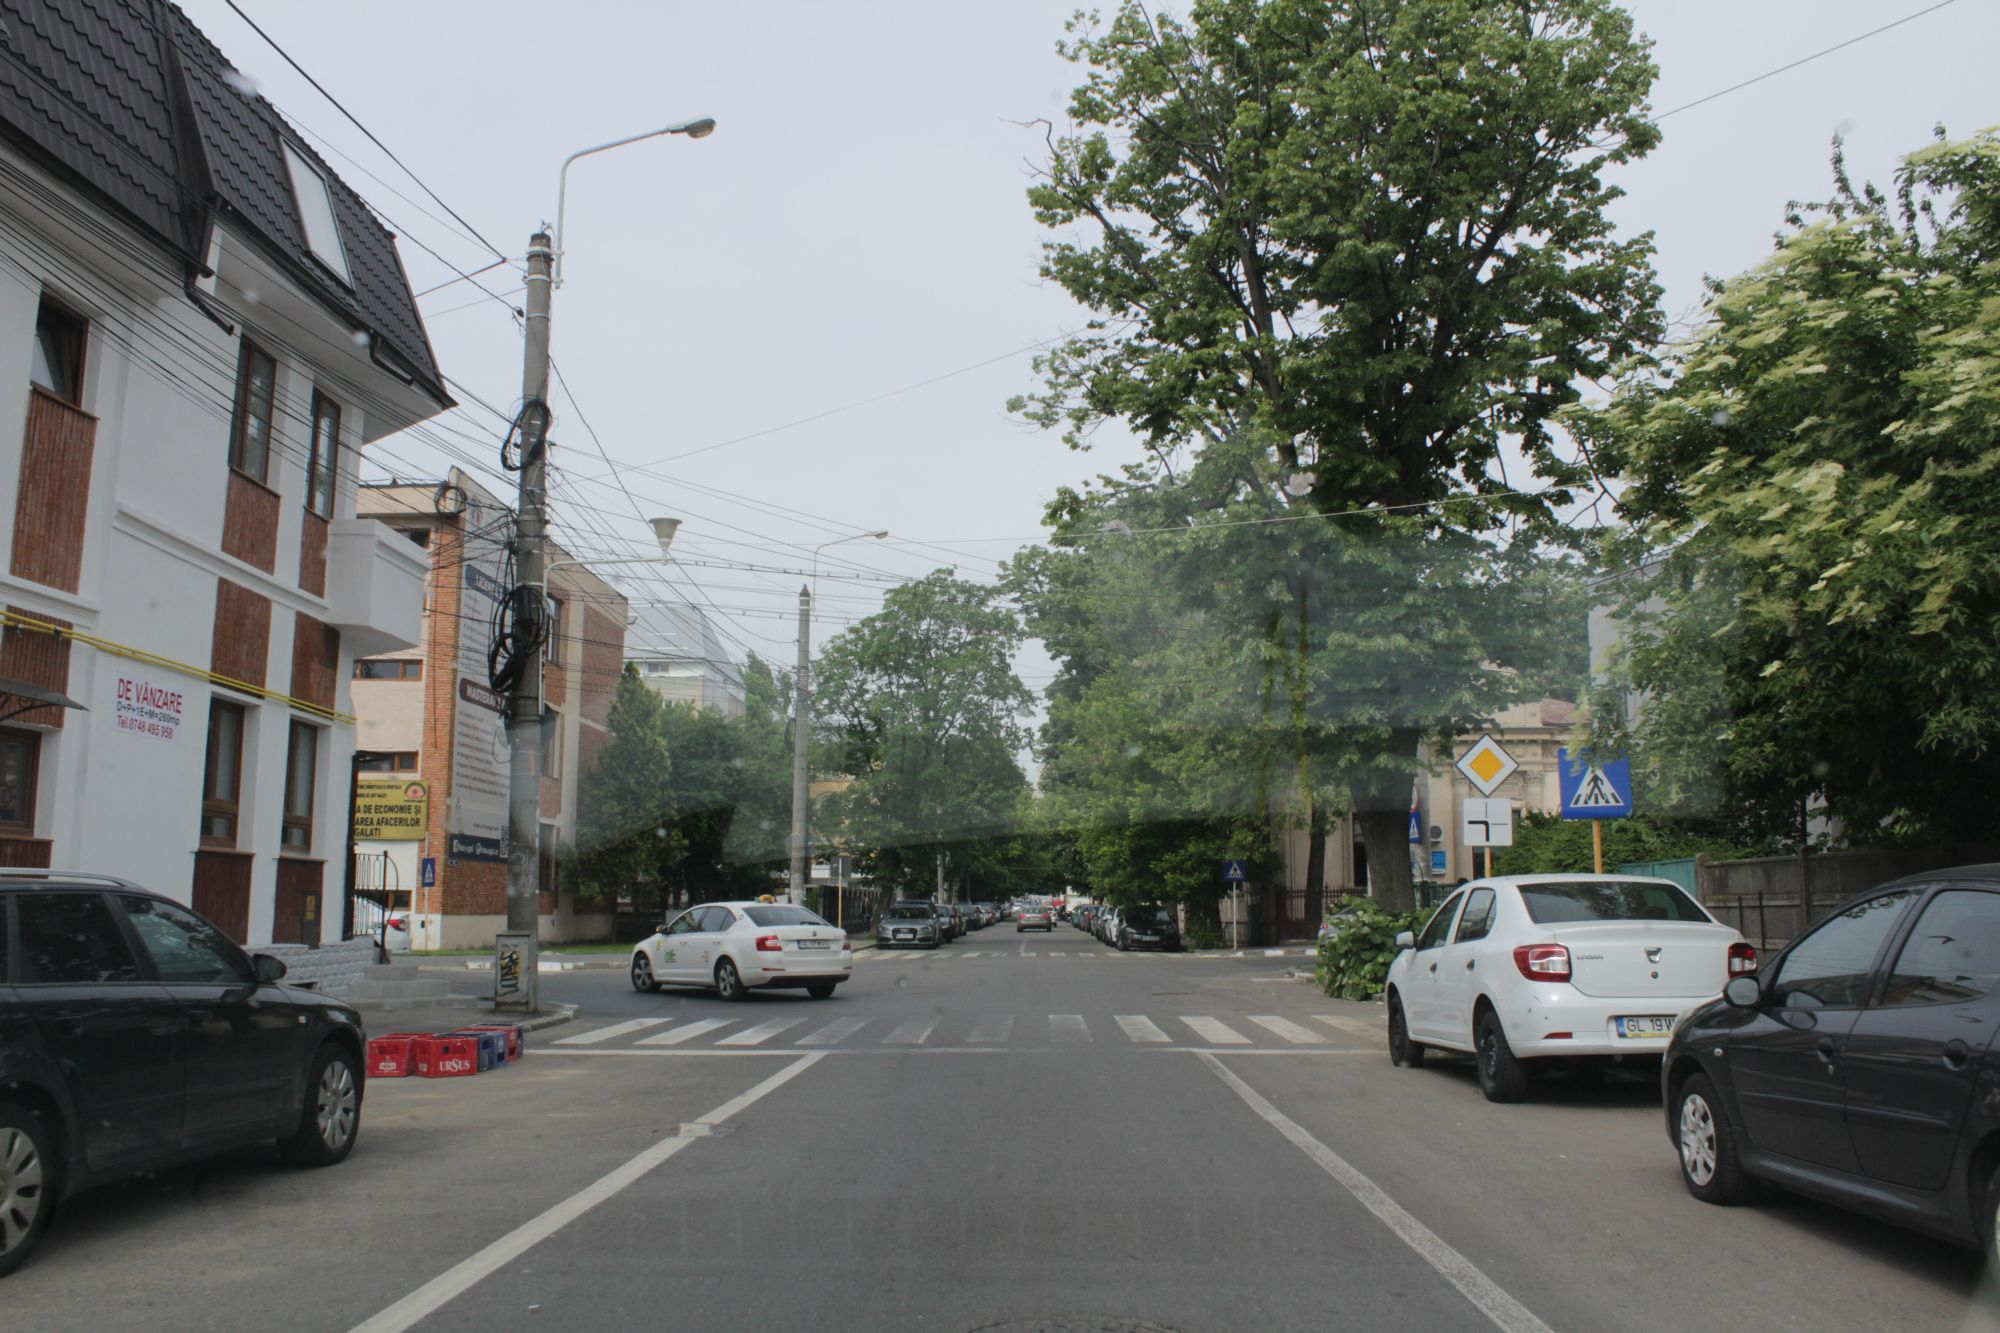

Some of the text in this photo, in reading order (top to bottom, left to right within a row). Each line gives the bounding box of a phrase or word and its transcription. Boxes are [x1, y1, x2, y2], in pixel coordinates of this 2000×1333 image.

[117, 678, 182, 714] DE VÂNZARE
[363, 805, 373, 814] DE
[374, 805, 412, 814] ECONOMIE
[376, 817, 420, 826] AFACERILOR
[1626, 1019, 1646, 1032] GL
[1649, 1018, 1663, 1032] 19
[439, 1059, 471, 1072] URSUS
